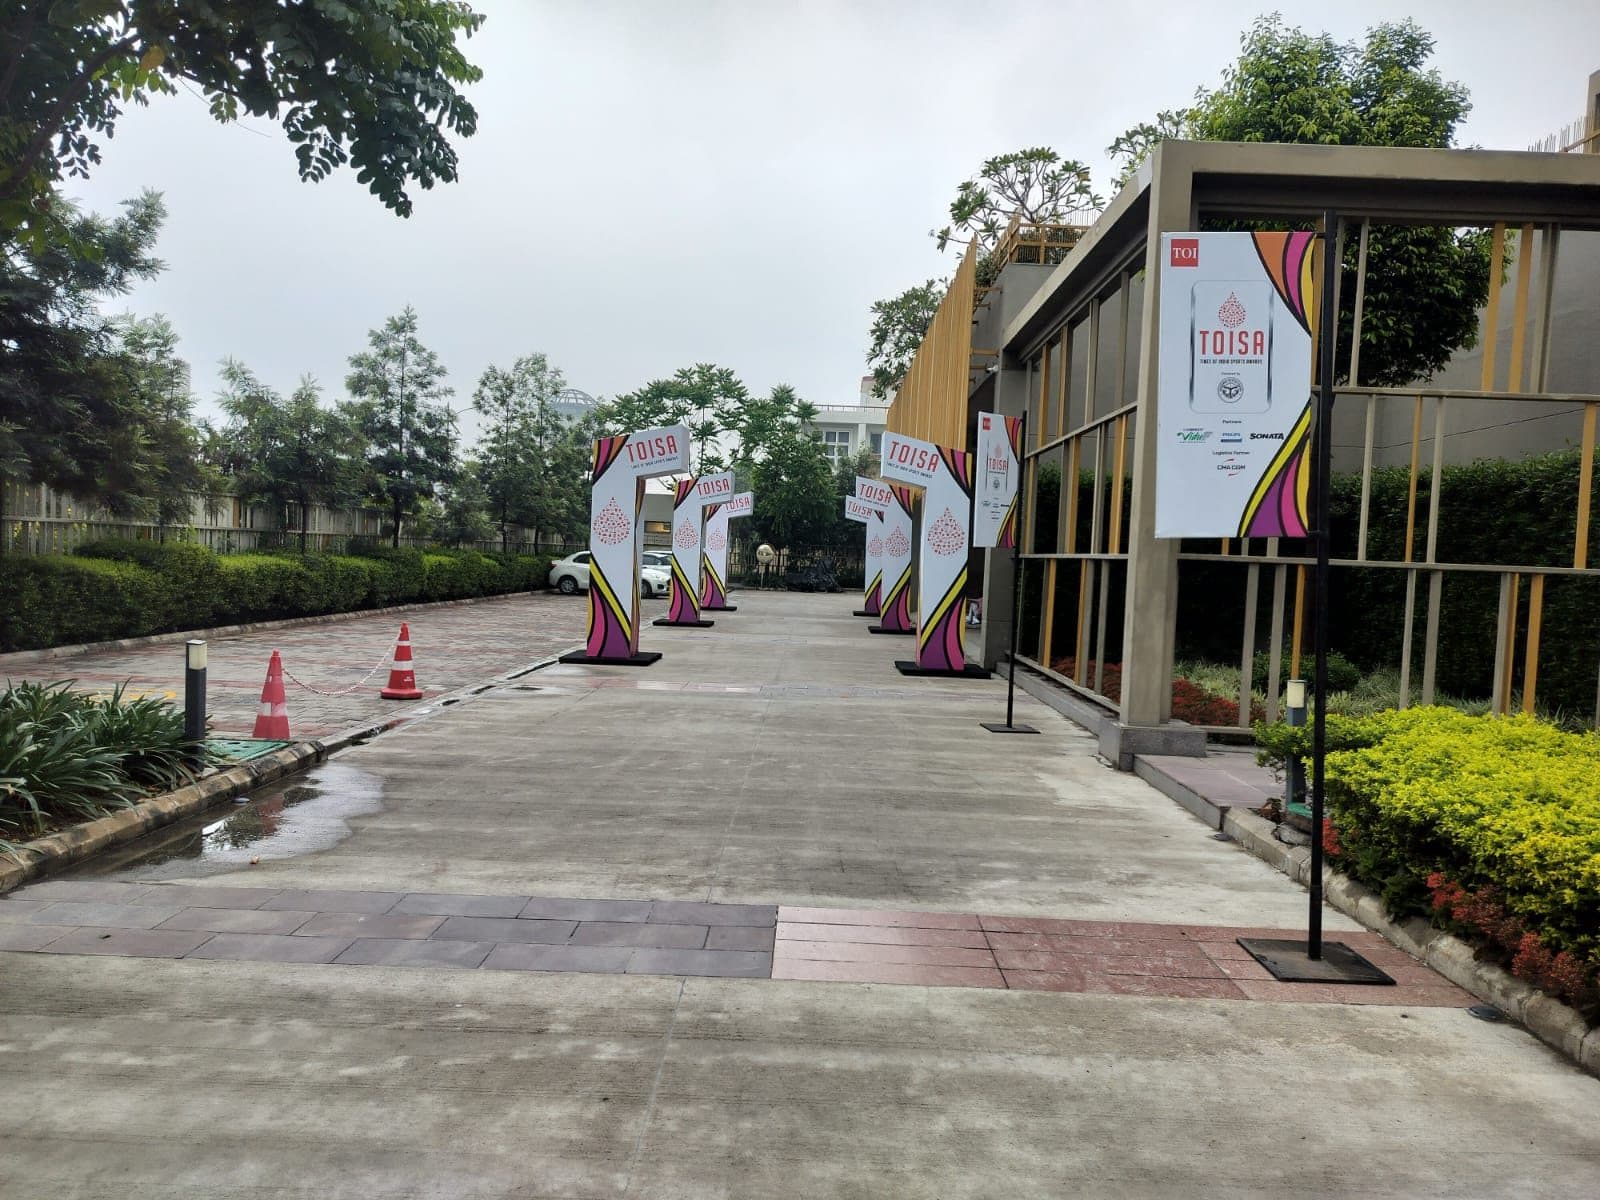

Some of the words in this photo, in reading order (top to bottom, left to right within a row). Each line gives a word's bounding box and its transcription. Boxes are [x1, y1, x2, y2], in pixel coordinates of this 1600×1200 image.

[1172, 247, 1197, 259] TOI
[1199, 330, 1265, 356] TOISA
[1249, 432, 1284, 440] SONATA
[625, 435, 678, 462] TOISA
[889, 441, 940, 473] TOISA
[696, 478, 730, 496] TOISA
[860, 483, 893, 503] TOISA
[847, 501, 873, 517] TOISA
